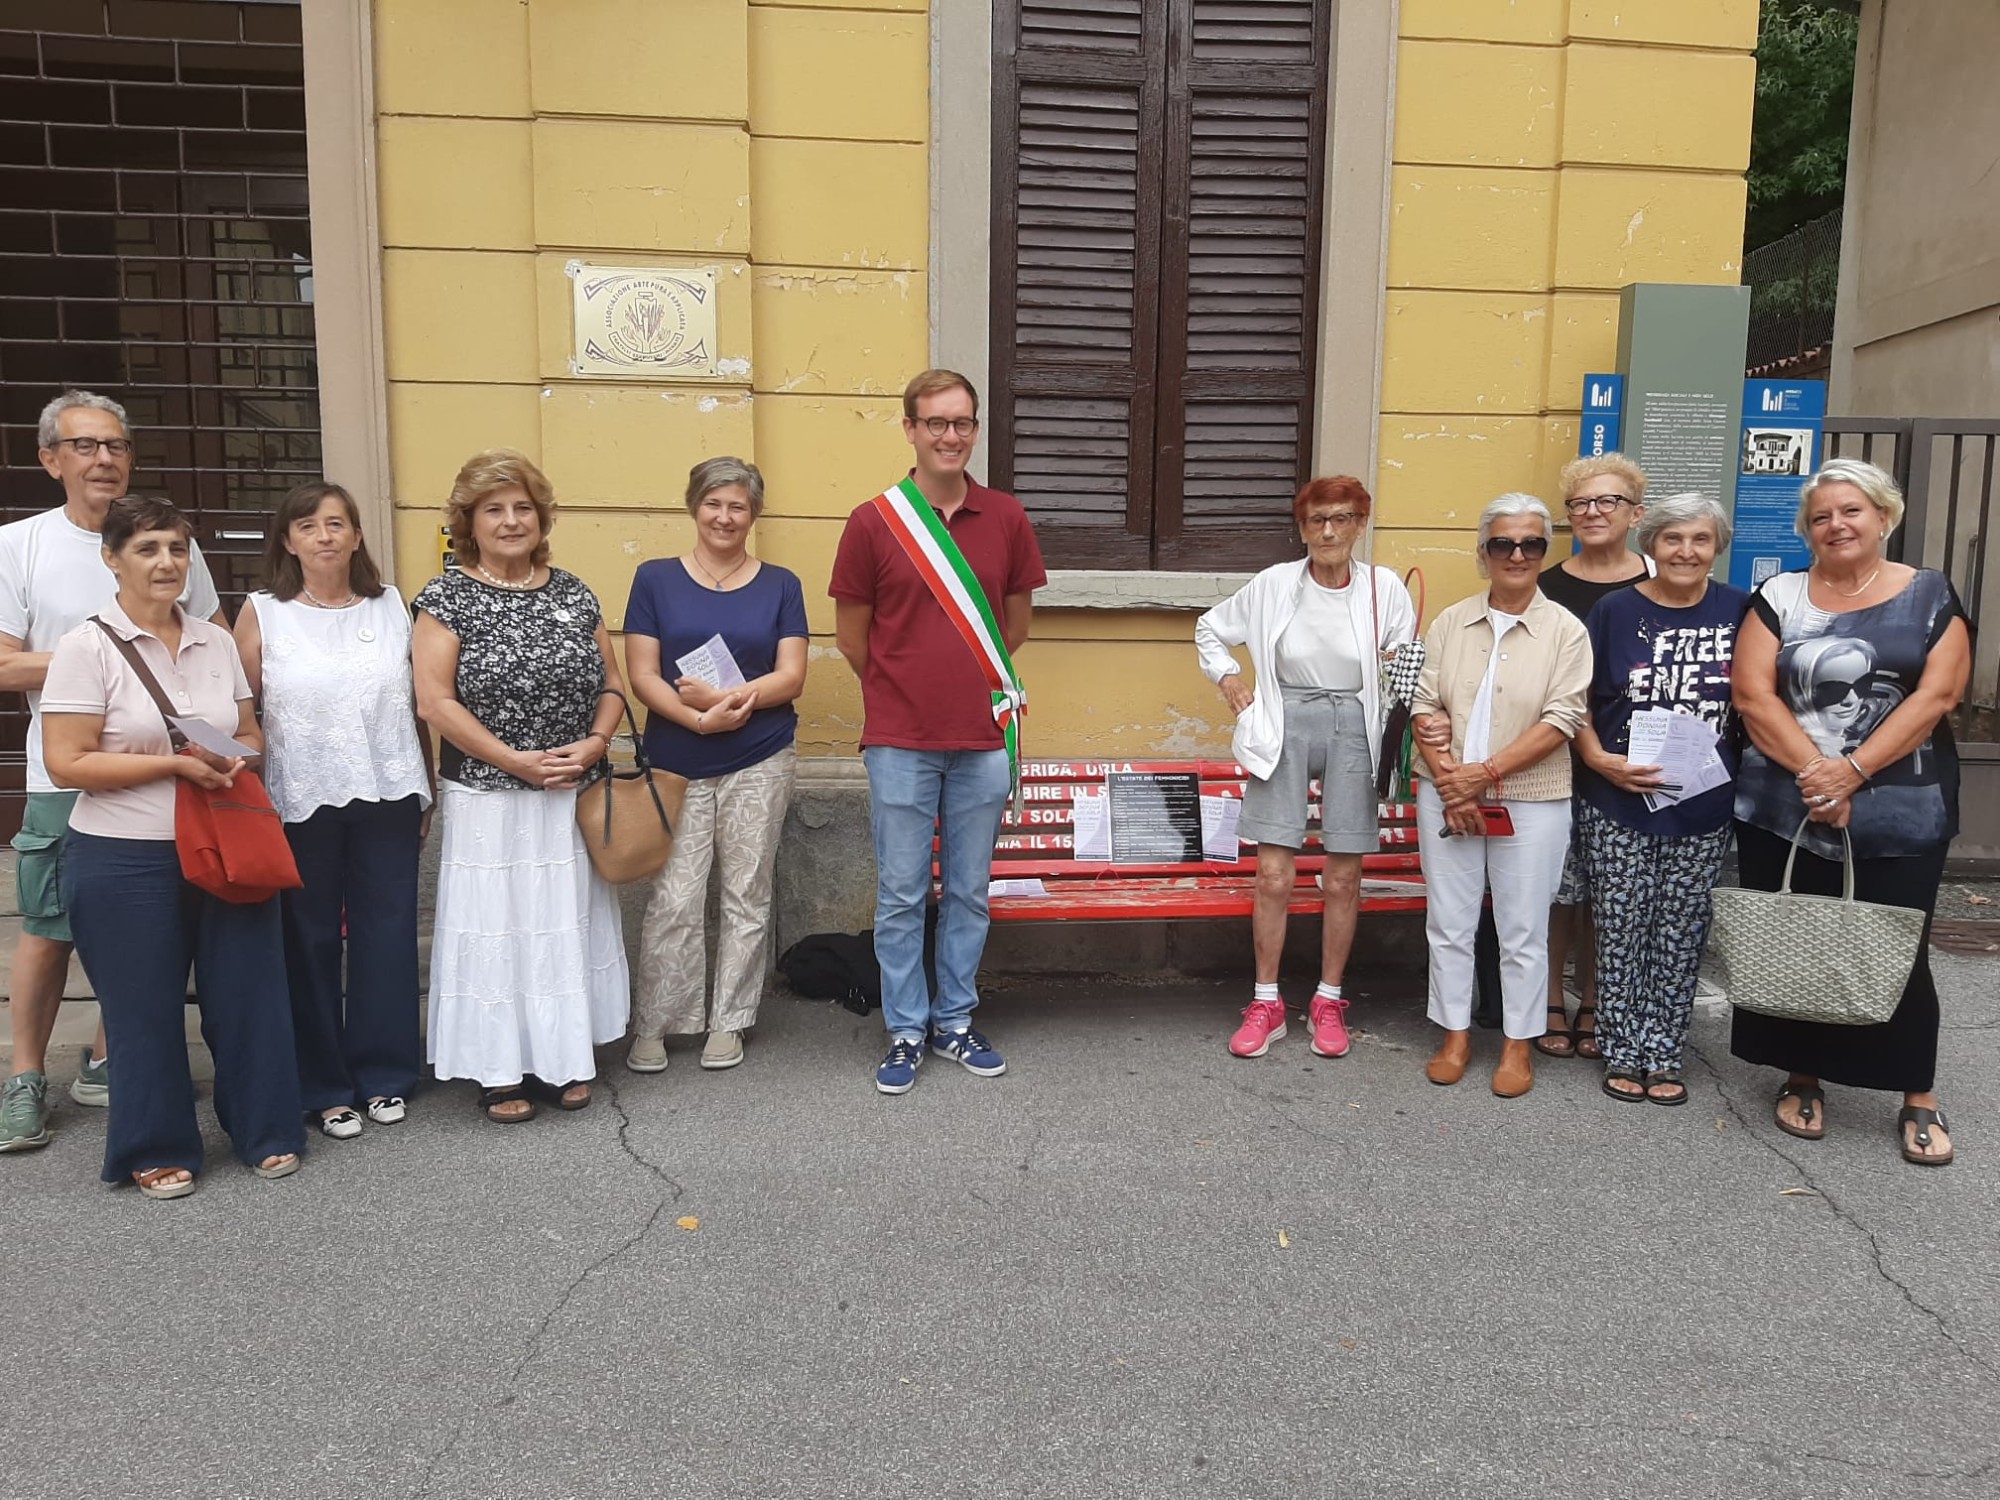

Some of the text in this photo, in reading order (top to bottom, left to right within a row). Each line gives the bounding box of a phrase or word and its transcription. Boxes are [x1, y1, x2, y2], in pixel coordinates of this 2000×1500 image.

[605, 284, 631, 328] ASSOCIAZIONE
[633, 280, 649, 288] ARTE
[650, 282, 668, 294] PURA
[670, 295, 686, 330] APPLICATA
[1592, 424, 1605, 459] ORSO
[1652, 624, 1733, 664] FREE
[1070, 786, 1087, 799] IN
[1030, 809, 1074, 824] SOLA
[1030, 835, 1047, 849] IL
[1052, 835, 1074, 848] 15
